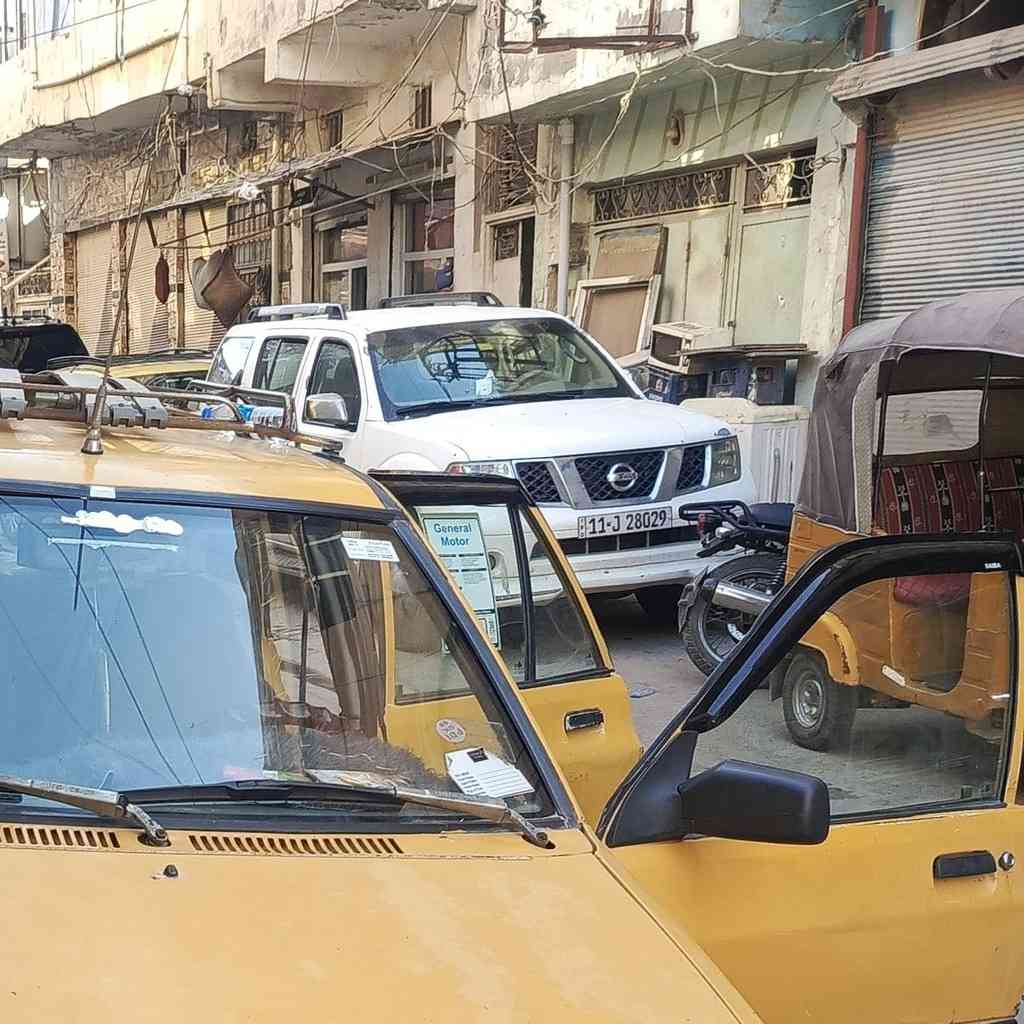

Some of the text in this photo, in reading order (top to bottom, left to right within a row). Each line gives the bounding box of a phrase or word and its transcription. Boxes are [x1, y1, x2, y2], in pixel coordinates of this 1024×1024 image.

[588, 515, 621, 535] 11-J
[626, 510, 667, 530] 28029
[433, 523, 472, 534] General
[440, 537, 469, 547] Motor
